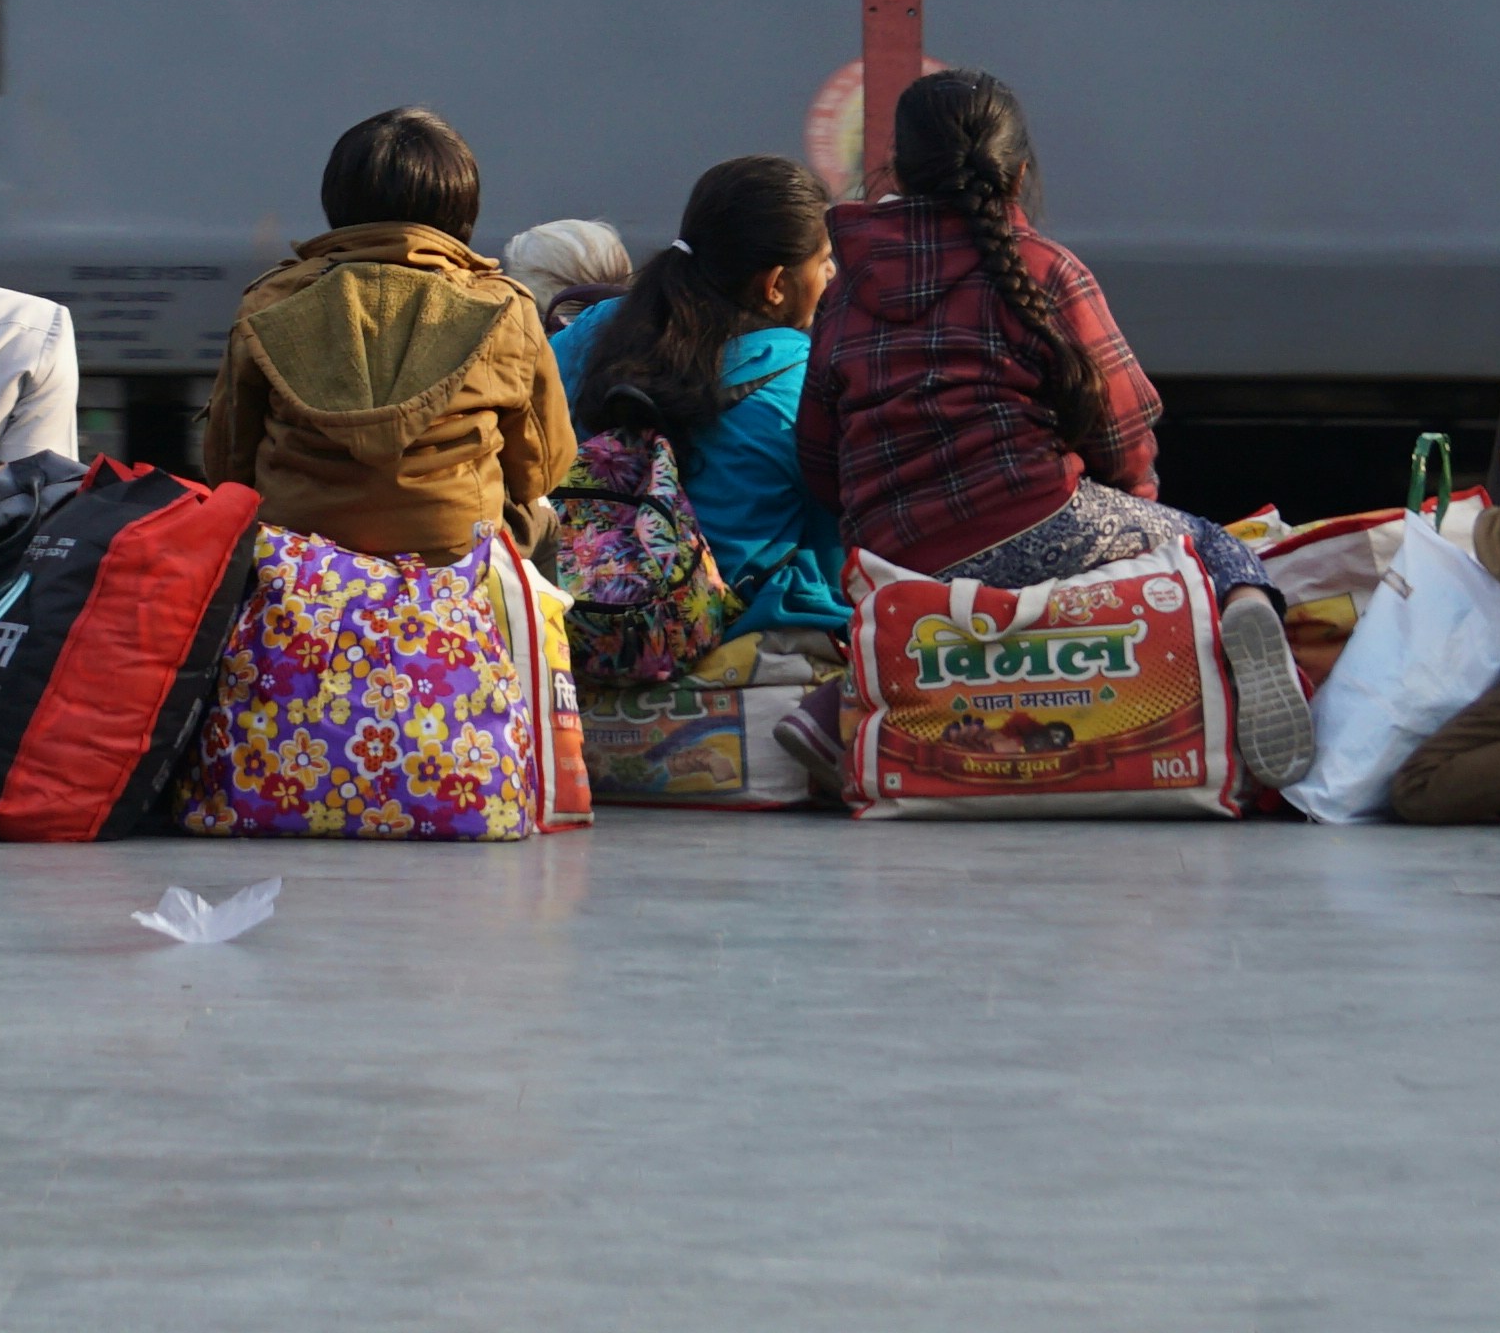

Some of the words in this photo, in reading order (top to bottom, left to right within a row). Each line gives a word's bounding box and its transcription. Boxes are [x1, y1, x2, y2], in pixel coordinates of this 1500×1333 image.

[908, 614, 1147, 688] विमल
[971, 694, 1014, 711] पान
[1018, 689, 1092, 708] मसाला
[961, 755, 1012, 775] केसर
[1016, 757, 1061, 781] युक्त
[1152, 748, 1199, 779] NO.1
